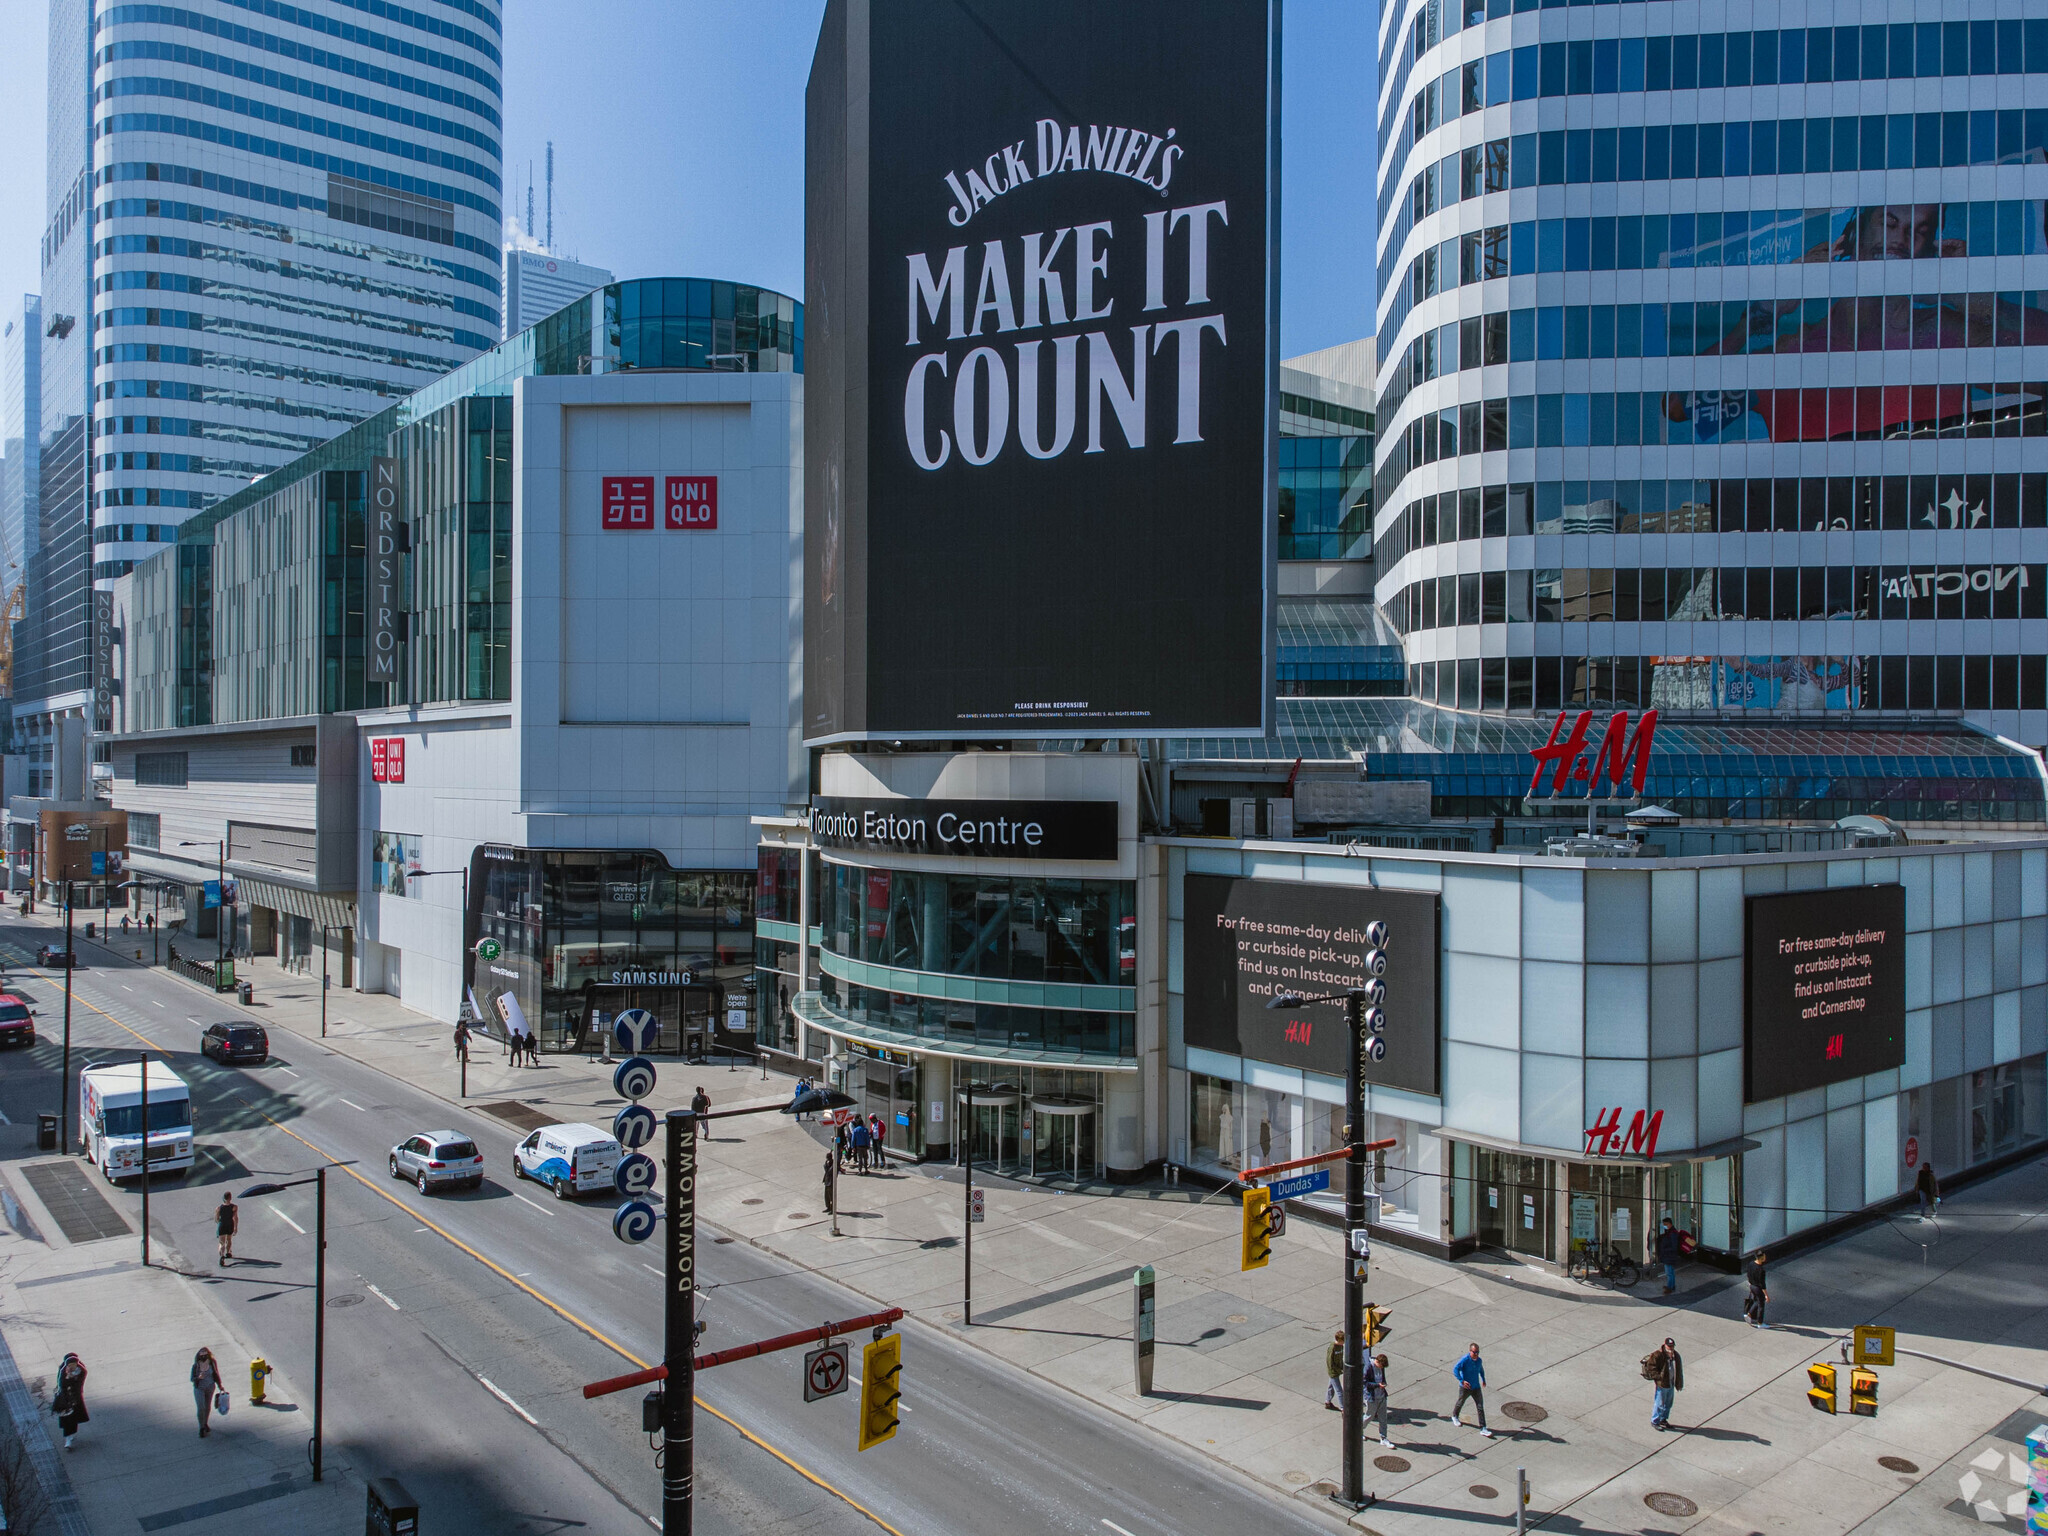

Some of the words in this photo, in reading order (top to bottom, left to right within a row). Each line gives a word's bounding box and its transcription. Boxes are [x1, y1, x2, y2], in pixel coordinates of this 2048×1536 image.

[944, 139, 1033, 227] JACK
[1036, 118, 1184, 192] DANIEL'S
[523, 257, 544, 269] BMO
[905, 220, 1114, 346] MAKE
[1142, 200, 1229, 311] IT
[904, 314, 1227, 470] COUNT
[376, 463, 394, 674] NORDSTROM
[98, 595, 111, 716] NORDSTROM
[1053, 701, 1089, 709] RESPONSIBLY
[1529, 710, 1658, 792] H&M
[814, 807, 857, 838] Toronto
[864, 811, 925, 841] Eaton
[936, 812, 1044, 846] Centre
[484, 847, 514, 860] SAMSUNG
[1217, 914, 1237, 929] For
[1239, 917, 1265, 932] free
[1267, 922, 1331, 943] same-day
[1779, 939, 1795, 954] For
[1795, 937, 1813, 952] free
[1814, 931, 1854, 949] same-day
[1855, 929, 1885, 944] delivery
[1238, 941, 1250, 950] or
[1253, 941, 1306, 958] curbside
[1309, 947, 1364, 968] pick-up,
[1795, 963, 1804, 975] or
[1805, 955, 1840, 973] curbside
[1841, 952, 1872, 971] pick-up,
[612, 971, 691, 985] SAMSUNG
[1238, 957, 1262, 974] find
[1265, 965, 1278, 976] us
[1281, 967, 1297, 978] on
[1300, 965, 1363, 987] Instacart
[1794, 981, 1812, 997] find
[1813, 983, 1823, 995] us
[1824, 981, 1834, 993] on
[1835, 973, 1872, 990] Instacart
[1248, 982, 1272, 996] and
[461, 1009, 472, 1018] 40
[1802, 1002, 1818, 1019] and
[1819, 996, 1866, 1015] Cornershop
[1284, 1020, 1312, 1046] H&M
[1584, 1107, 1664, 1159] H&M
[1278, 1178, 1312, 1196] Dundas
[1315, 1174, 1320, 1182] St
[679, 1130, 694, 1292] DOWNTOWN
